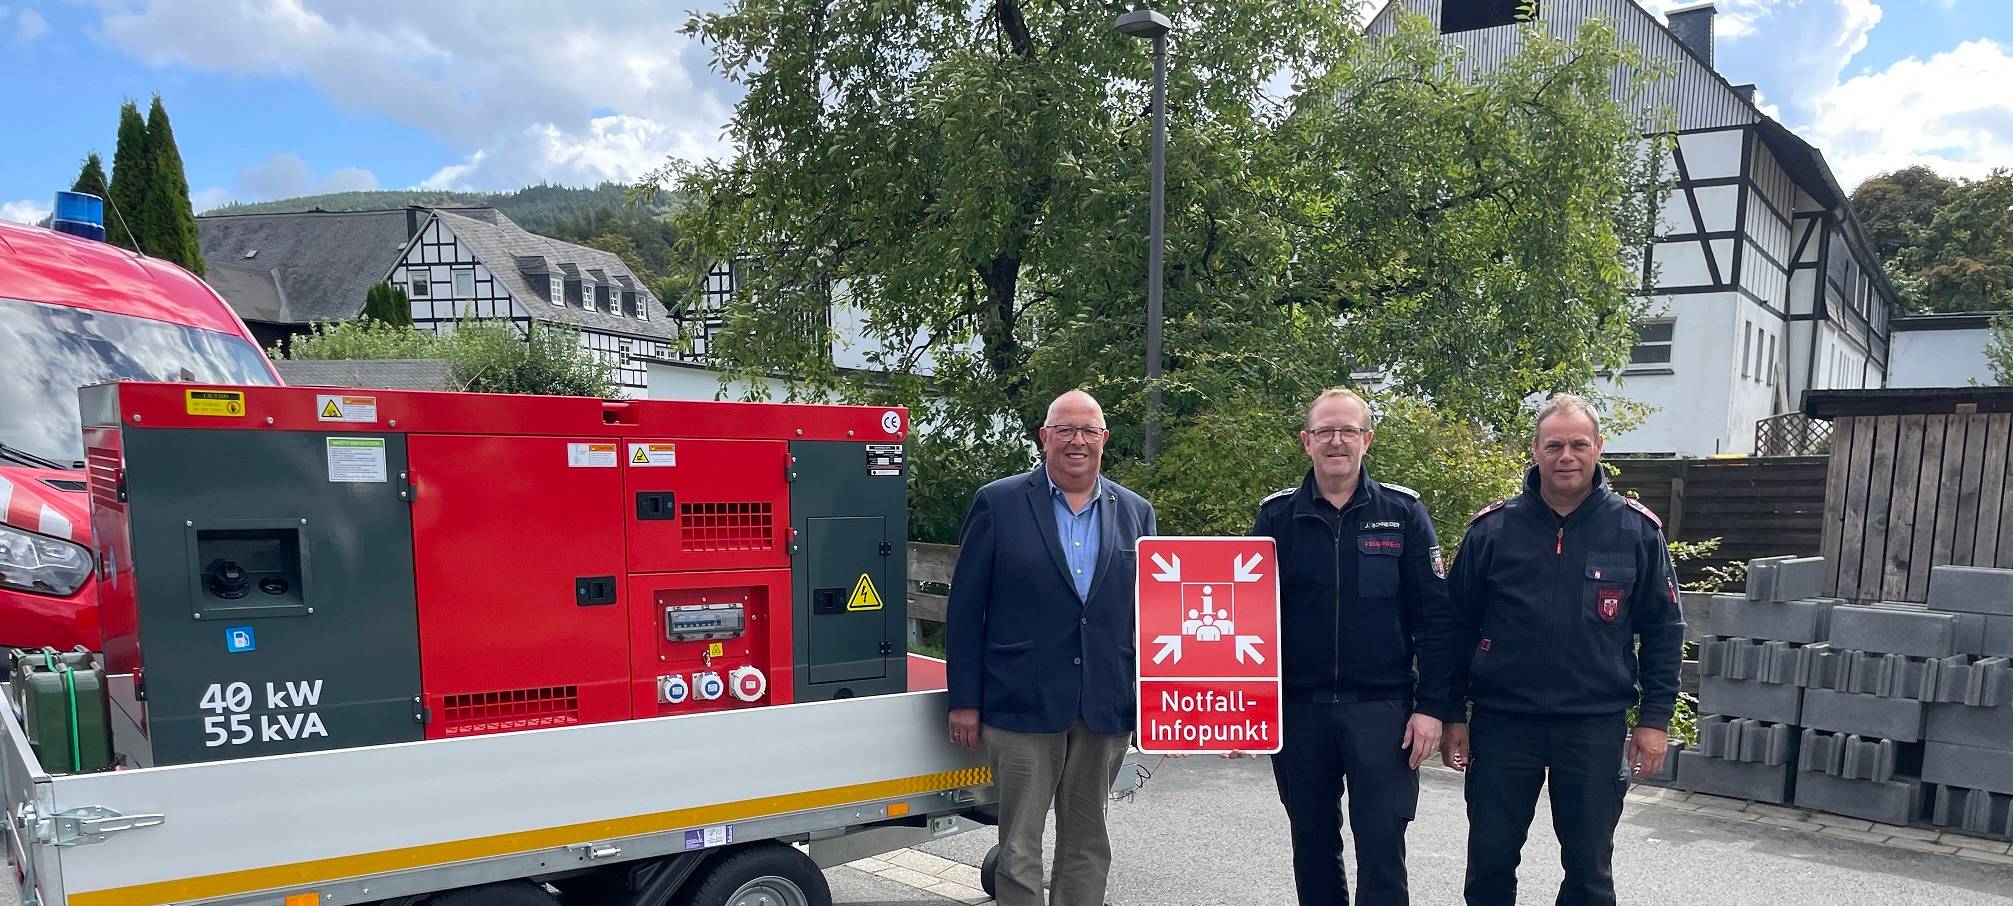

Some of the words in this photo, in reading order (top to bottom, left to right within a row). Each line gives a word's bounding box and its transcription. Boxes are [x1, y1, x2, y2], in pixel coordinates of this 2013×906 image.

[884, 416, 898, 428] CE
[199, 681, 253, 714] 40
[266, 679, 323, 709] kW
[1161, 690, 1257, 712] Notfall-
[204, 713, 254, 747] 55
[260, 712, 329, 742] kVA
[1151, 719, 1268, 746] Infopunkt
